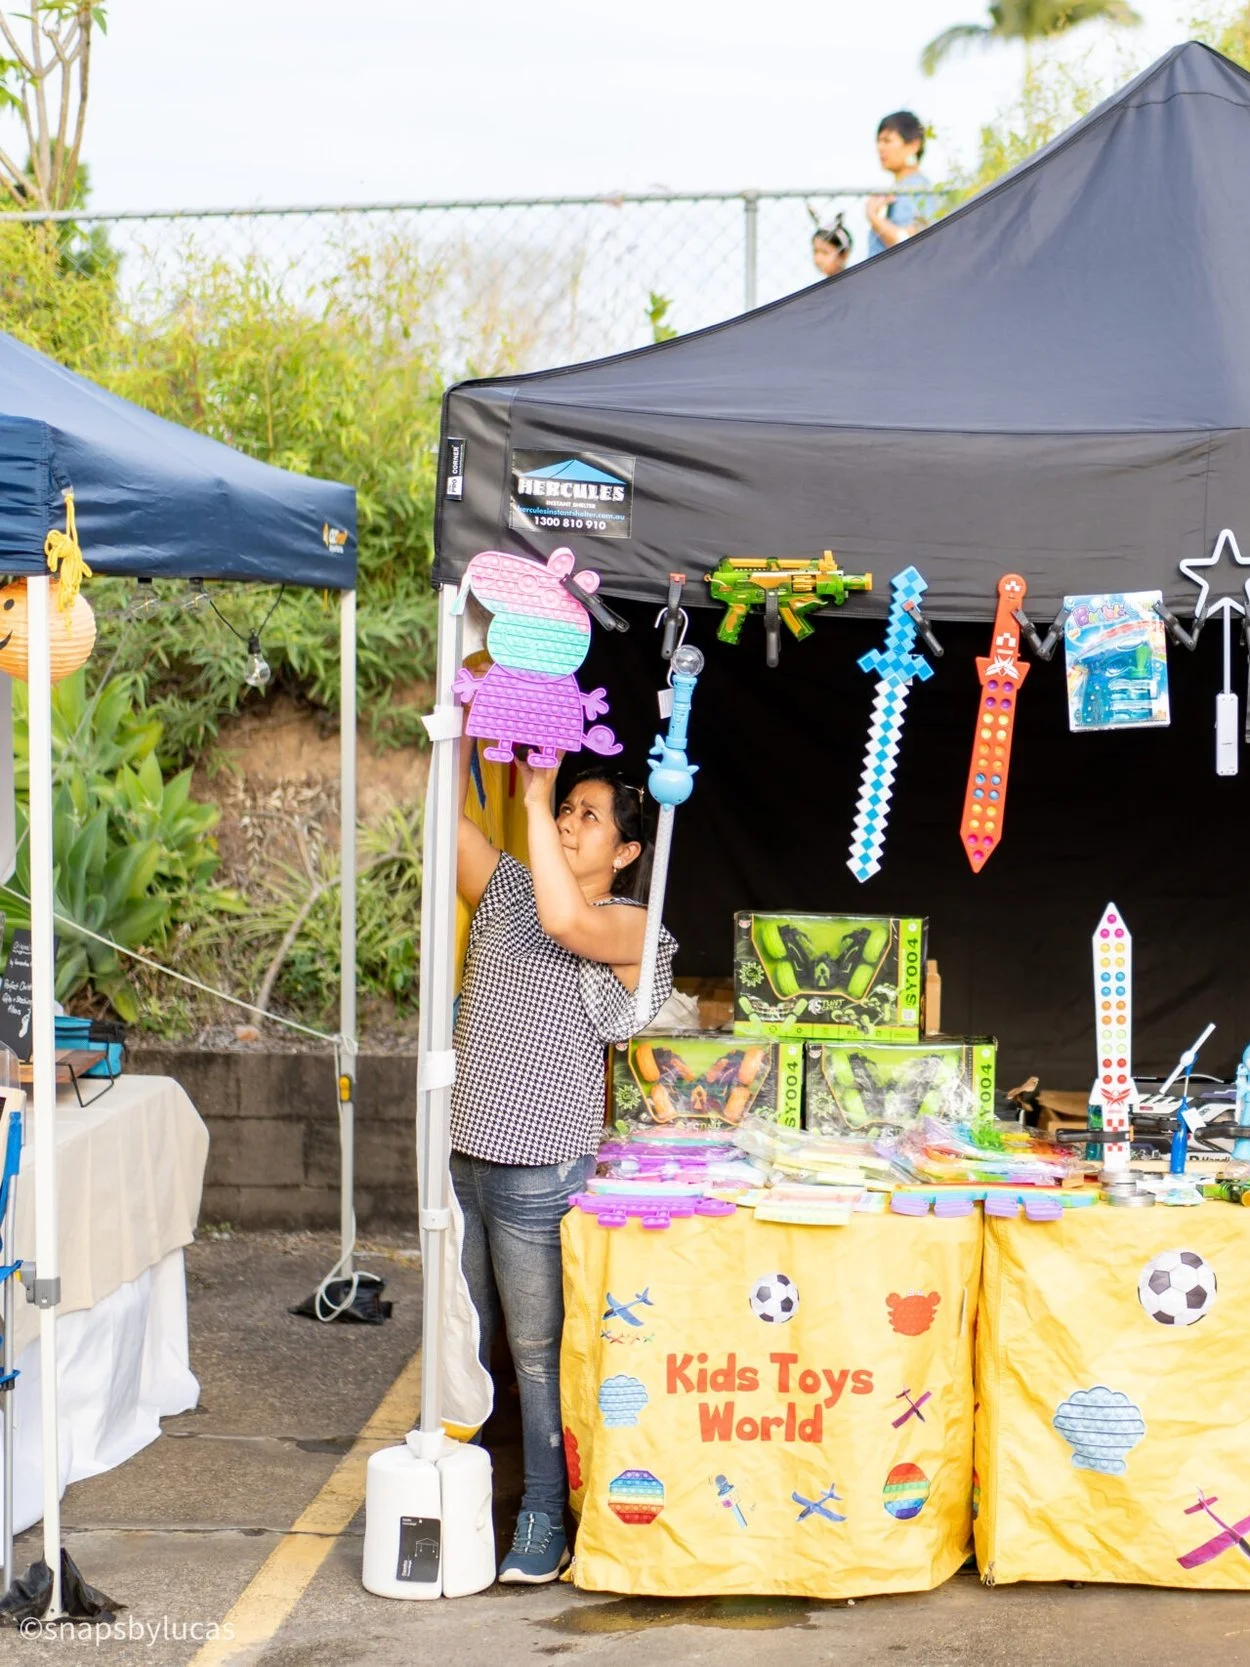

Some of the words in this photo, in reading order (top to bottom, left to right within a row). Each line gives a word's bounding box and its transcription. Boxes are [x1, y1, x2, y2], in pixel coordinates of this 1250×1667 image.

[452, 446, 460, 474] CORNER
[518, 478, 625, 502] HERCULES
[573, 501, 596, 509] SHELTER
[534, 516, 560, 527] 1300
[563, 518, 582, 529] 810
[586, 519, 606, 530] 910
[666, 1353, 760, 1394] Kids
[770, 1352, 874, 1409] Toys
[698, 1401, 824, 1443] World
